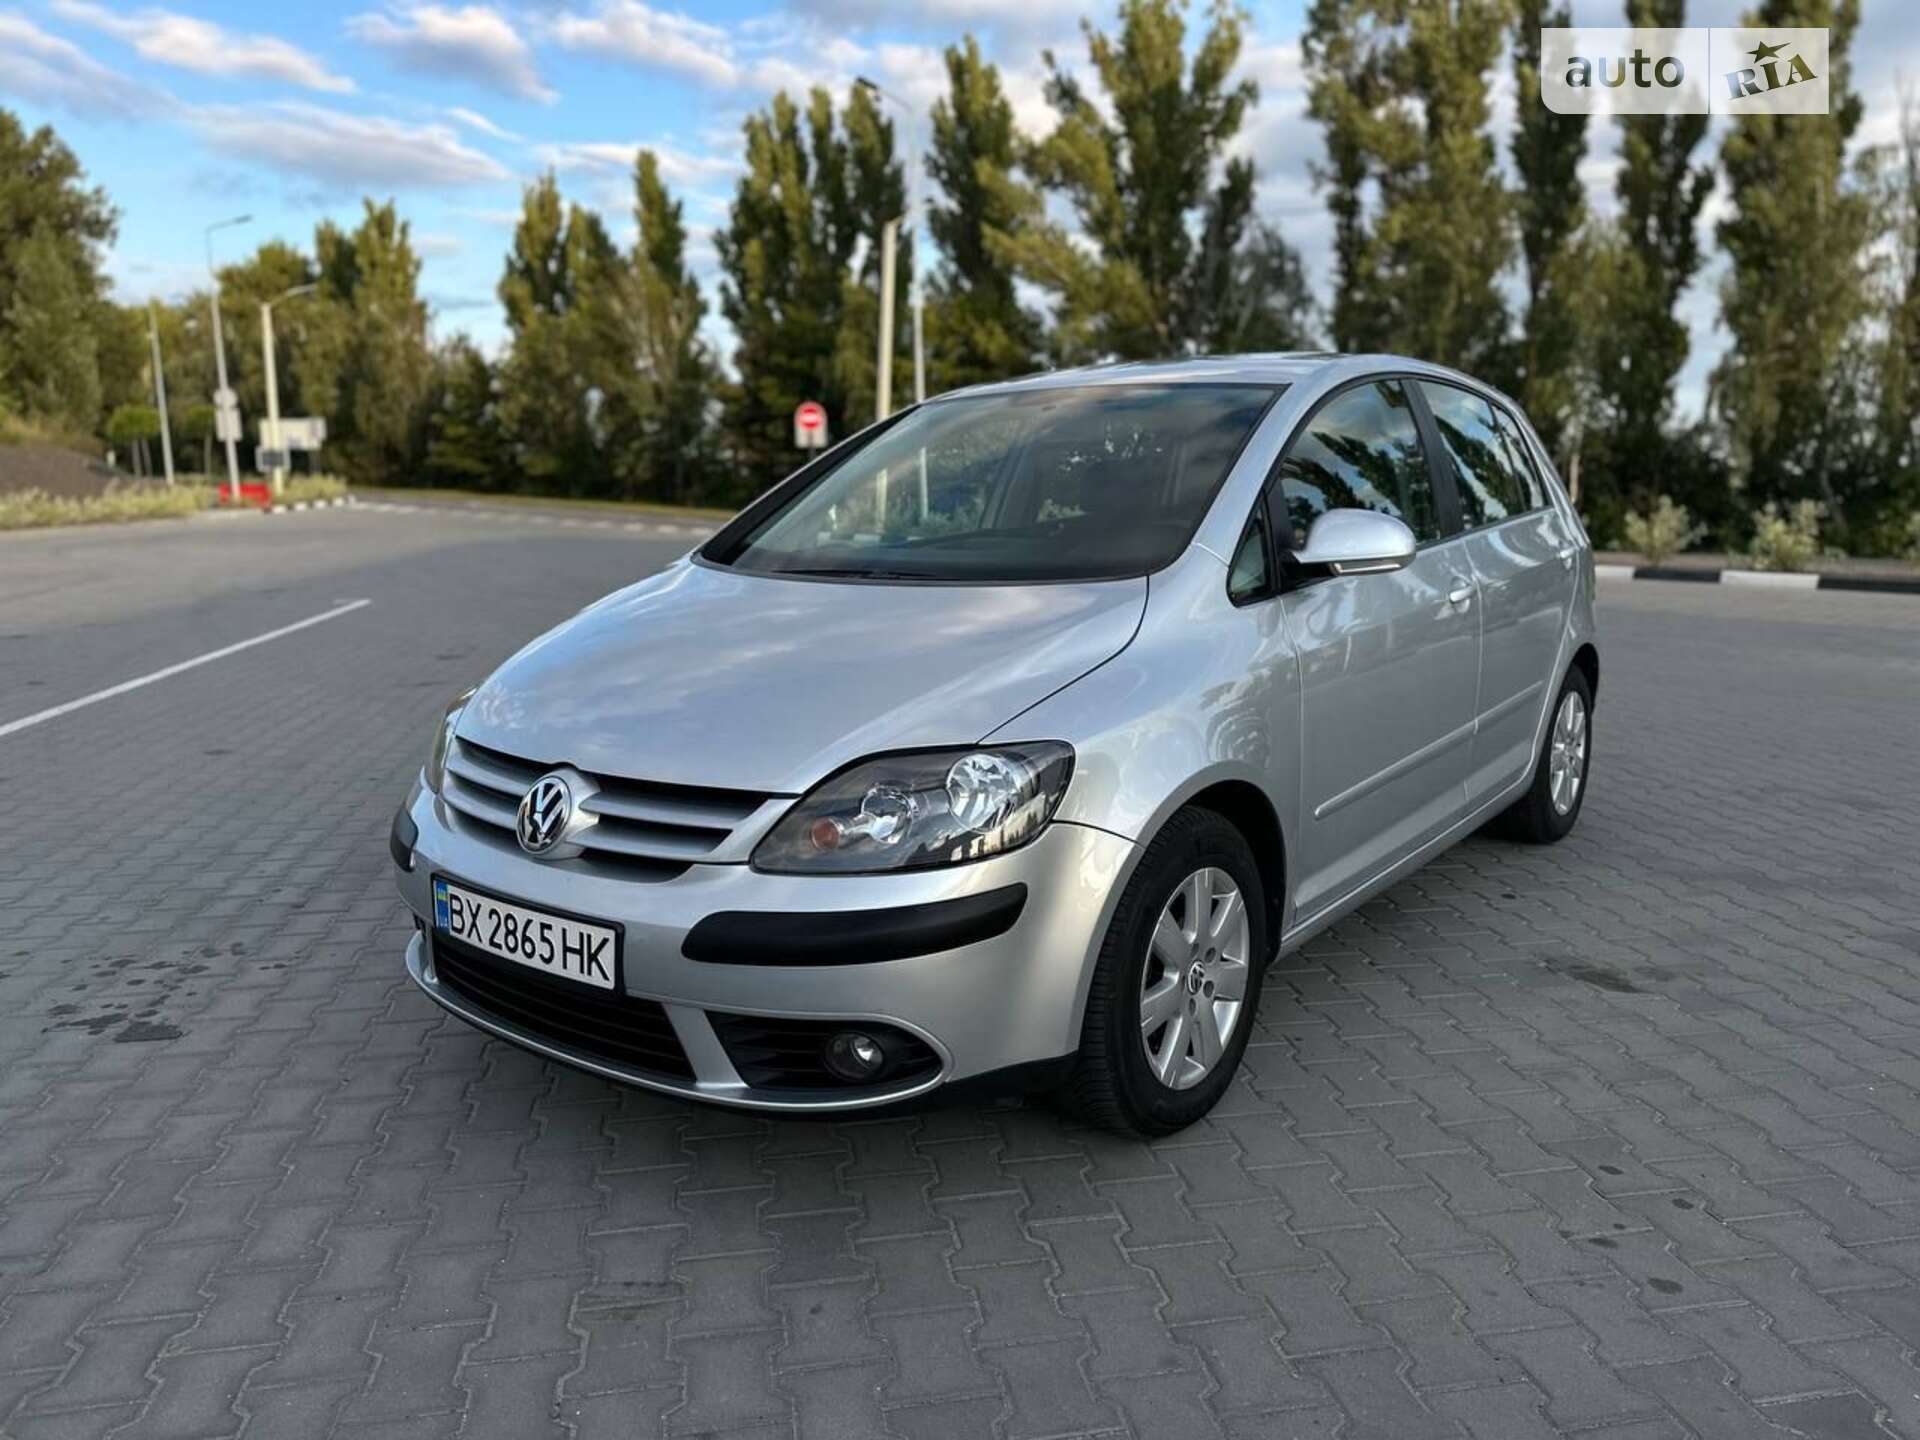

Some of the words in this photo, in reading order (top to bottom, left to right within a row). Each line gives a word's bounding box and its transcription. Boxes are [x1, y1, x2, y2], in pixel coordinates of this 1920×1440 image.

[450, 894, 482, 943] BX
[488, 909, 554, 964] 2865
[562, 928, 609, 981] HK
